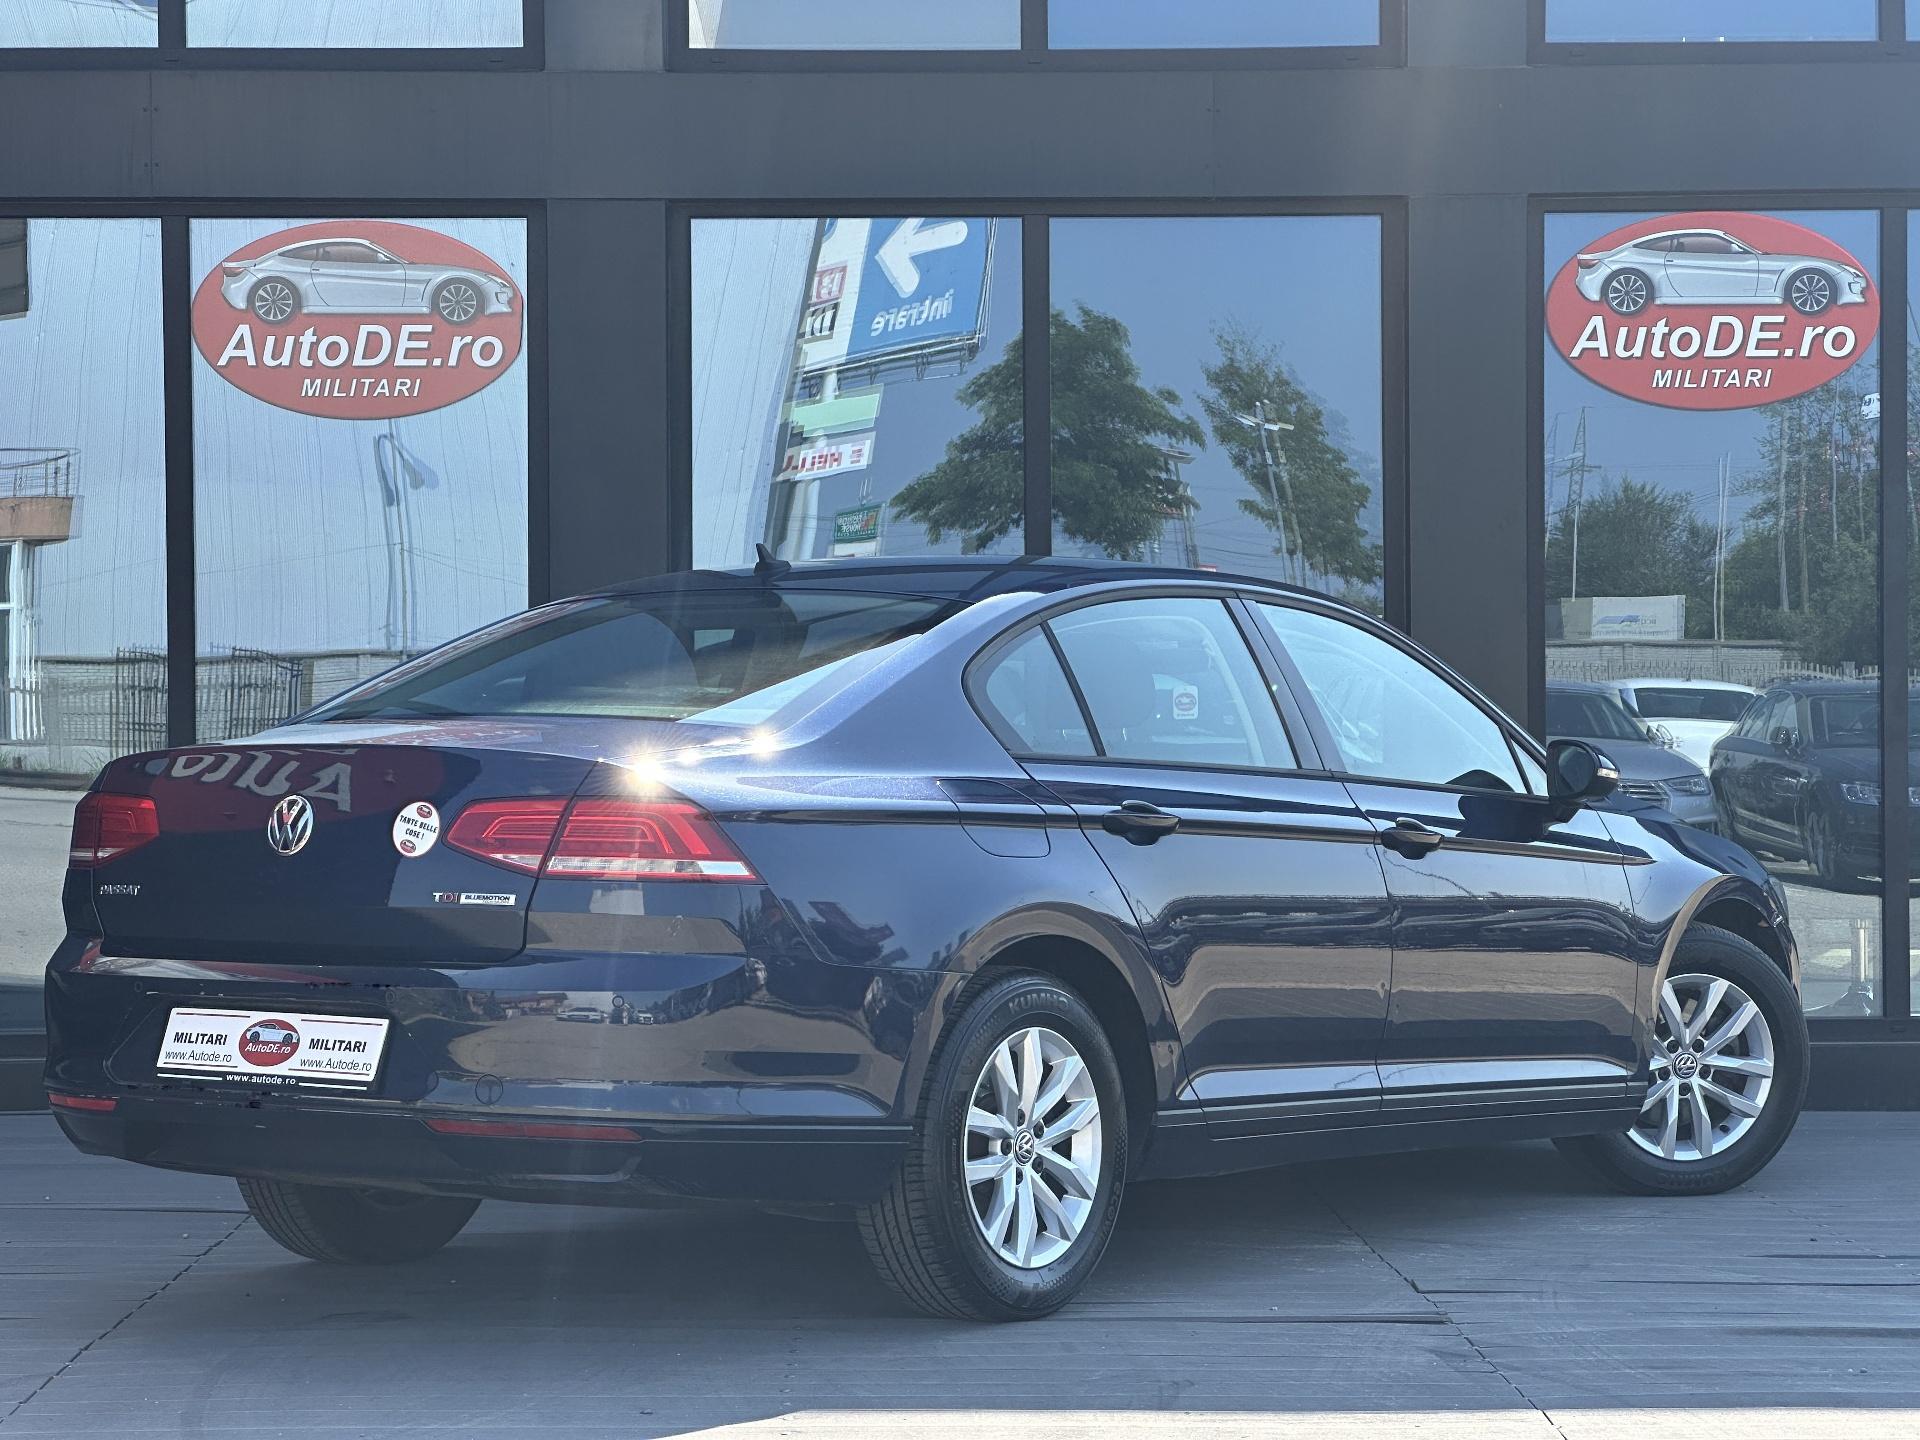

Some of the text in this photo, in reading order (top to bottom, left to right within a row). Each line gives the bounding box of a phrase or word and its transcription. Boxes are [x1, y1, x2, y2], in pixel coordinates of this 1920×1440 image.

[1569, 315, 1856, 359] AutoDE.ro
[217, 324, 504, 369] AutoDE.ro
[1652, 368, 1772, 389] MILITARI
[301, 377, 421, 398] MILITARI
[399, 814, 438, 834] TANTE BELLE
[405, 828, 421, 840] COSE
[100, 884, 141, 896] PASSAT
[432, 892, 511, 903] TDI BLUEMOTION
[173, 1031, 228, 1046] MILITARI
[308, 1038, 367, 1053] MILITARI
[244, 1042, 291, 1054] AutoDE.ro
[164, 1049, 232, 1063] www.Autode.ro
[300, 1056, 372, 1072] www.Autode.ro
[226, 1073, 296, 1085] www.autode.ro
